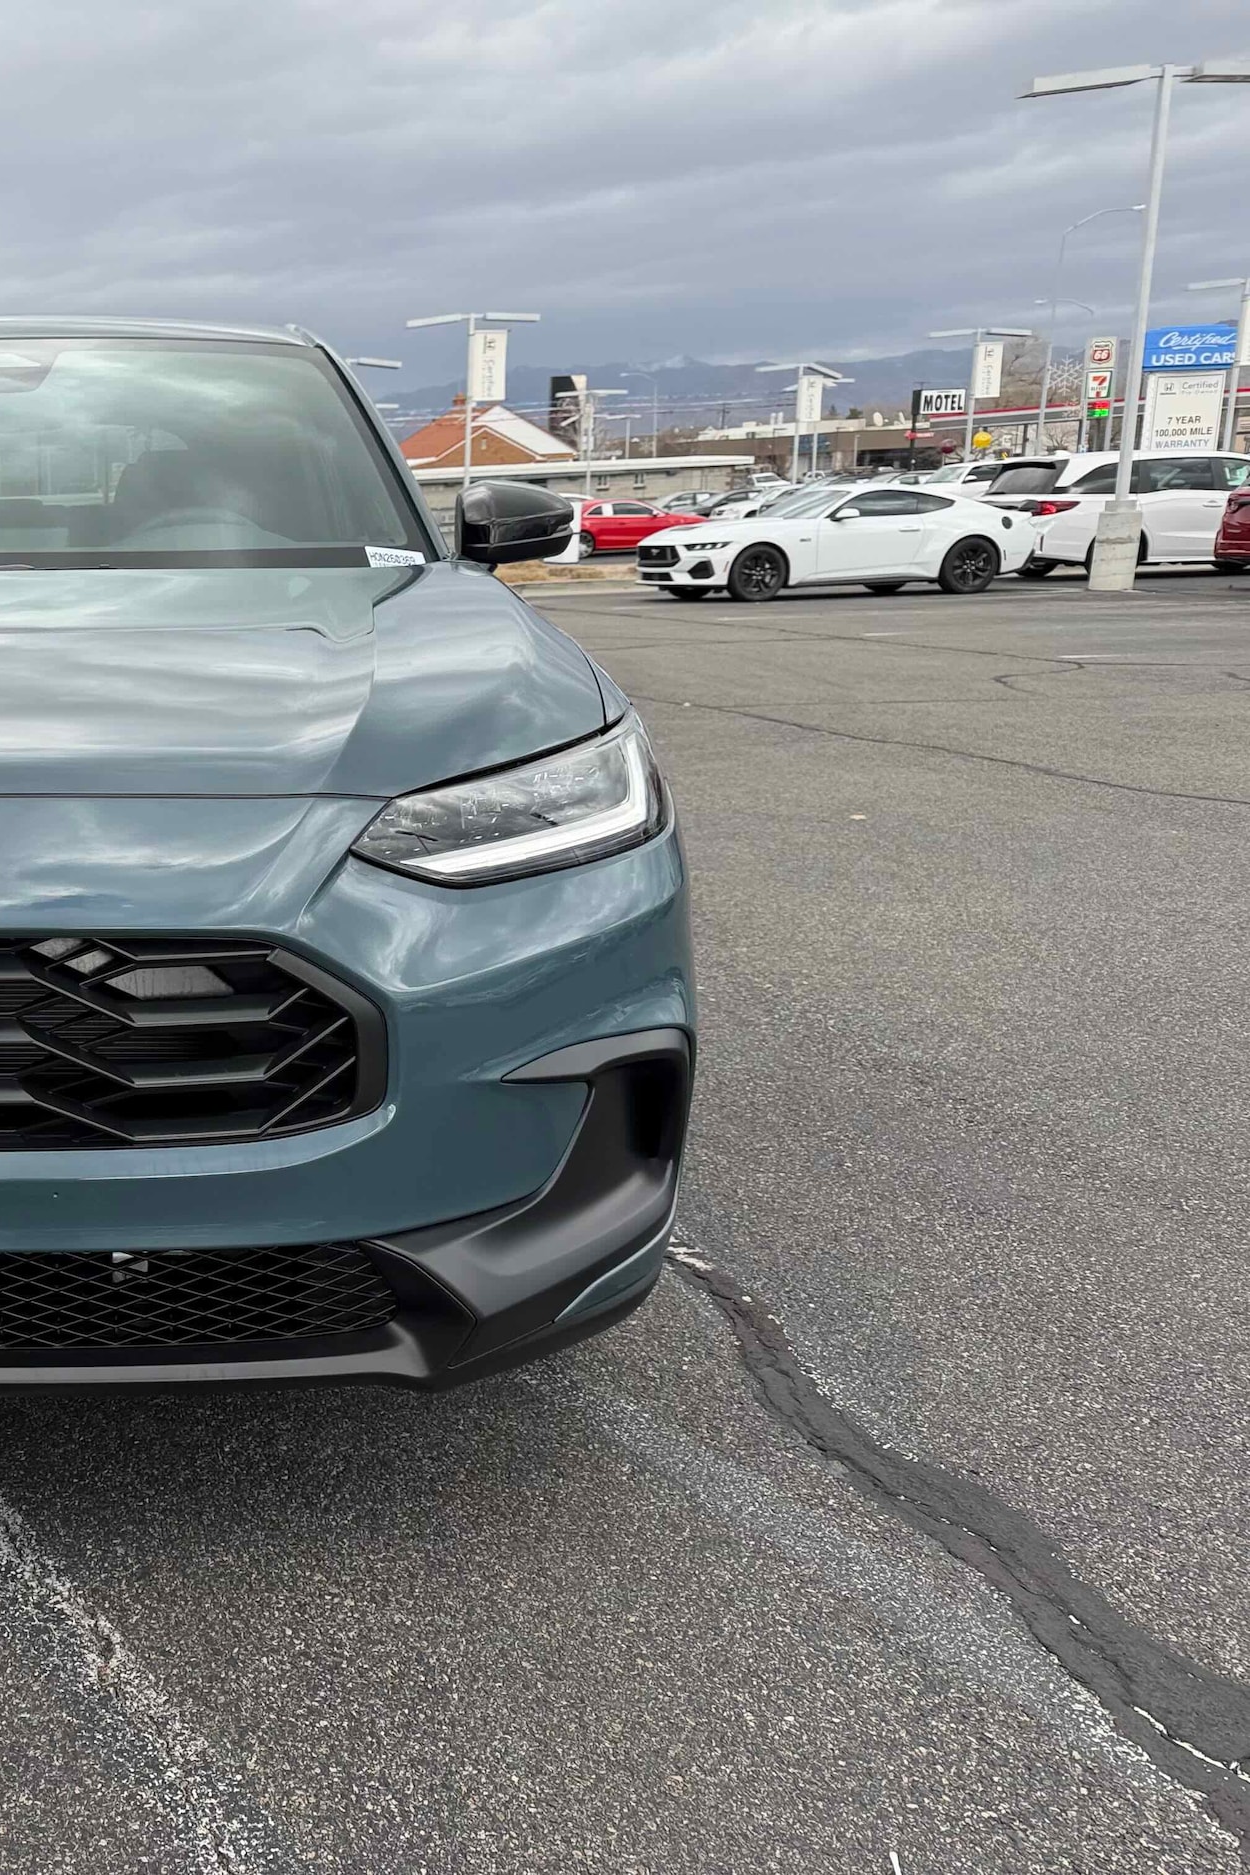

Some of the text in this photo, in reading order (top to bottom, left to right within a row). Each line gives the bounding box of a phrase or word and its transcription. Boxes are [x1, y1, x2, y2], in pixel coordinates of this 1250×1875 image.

[1159, 332, 1237, 351] Certified
[1093, 350, 1110, 360] 66
[1152, 353, 1197, 366] USED
[1092, 375, 1108, 387] 7
[1181, 380, 1219, 390] Certified
[923, 393, 964, 412] MOTEL
[1167, 415, 1202, 425] 7 YEAR
[1154, 426, 1213, 438] 100,000 MILE
[1155, 438, 1210, 449] WARRANTY
